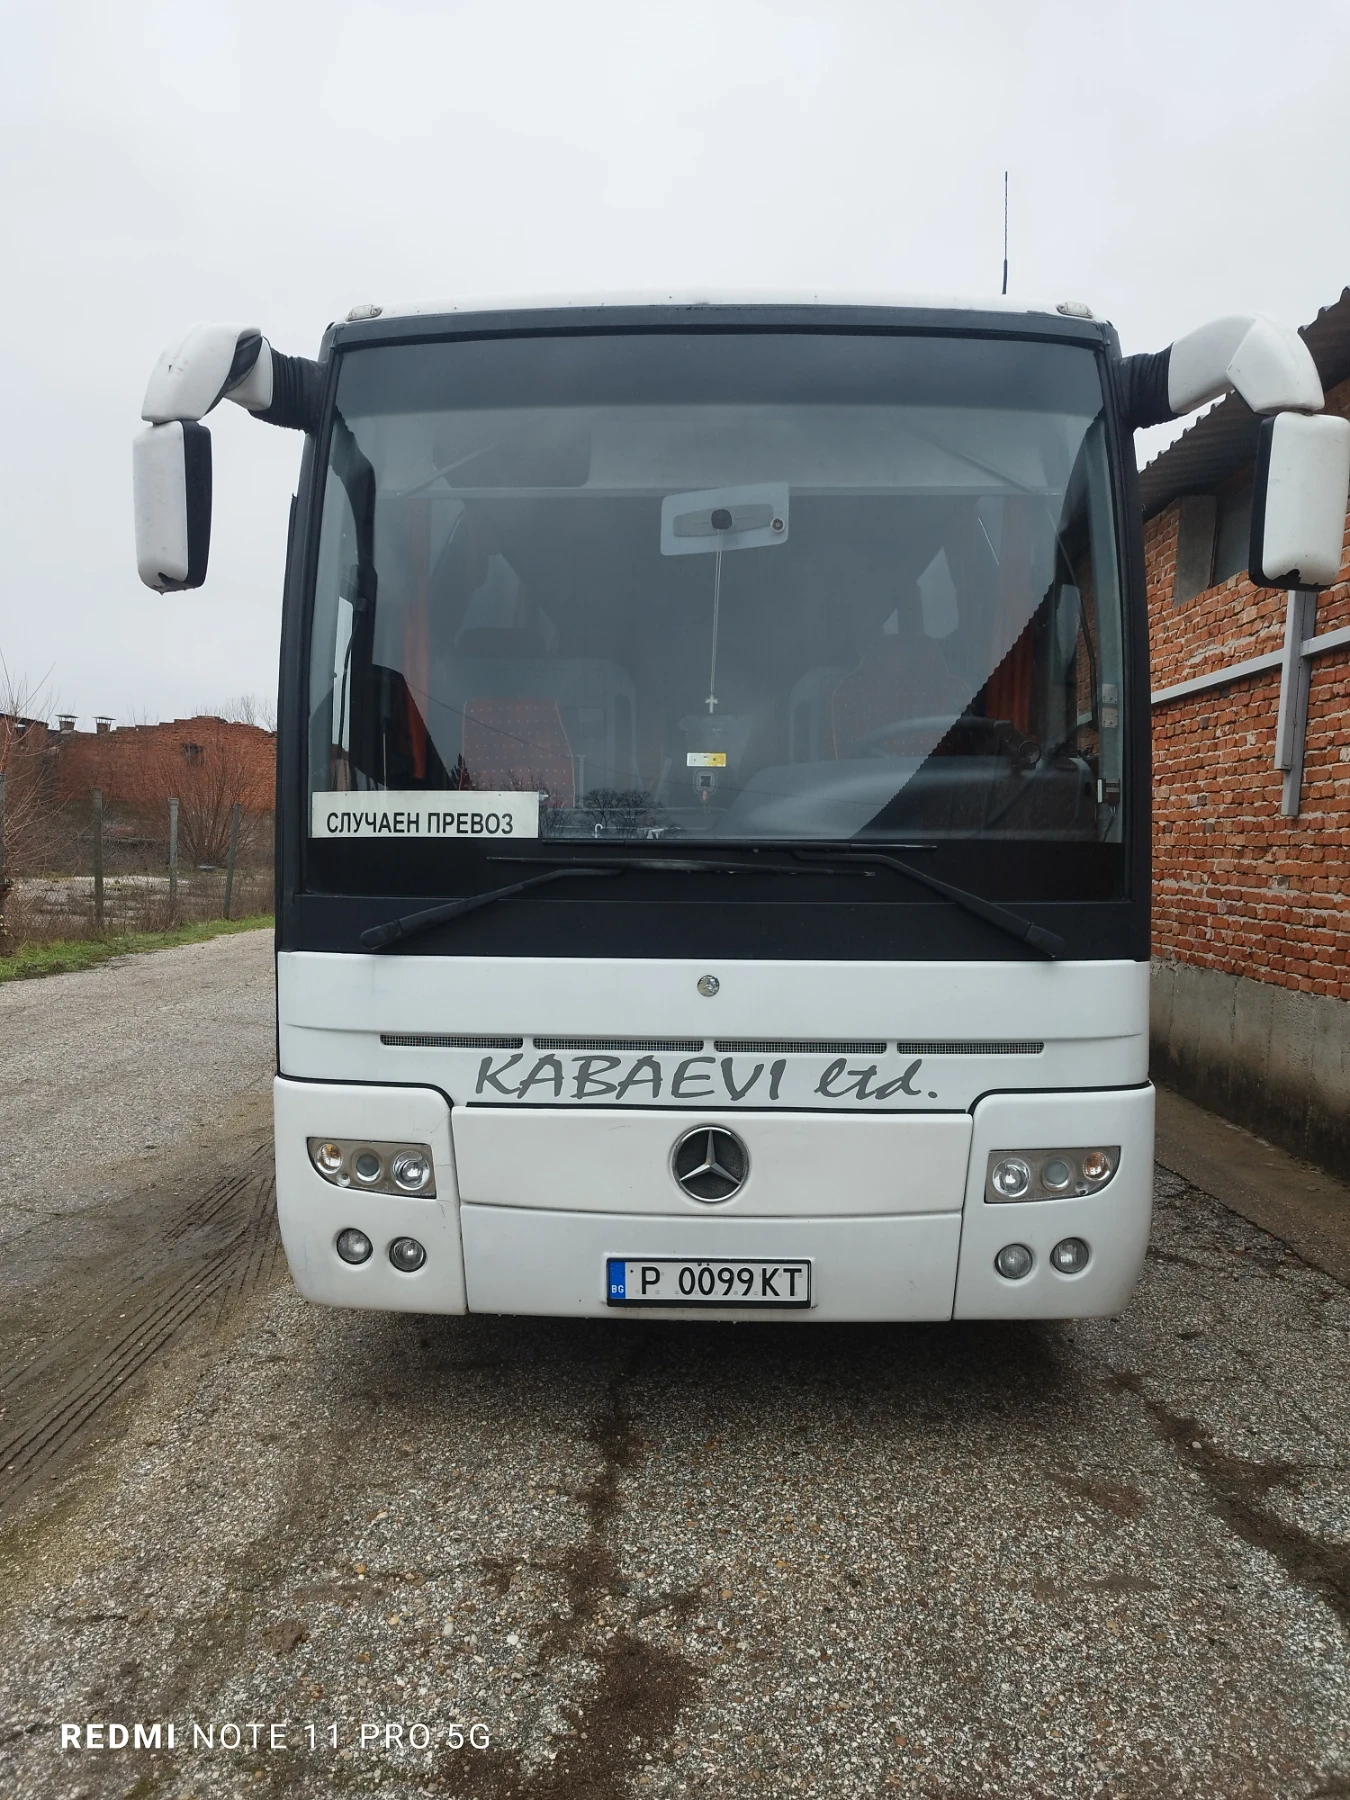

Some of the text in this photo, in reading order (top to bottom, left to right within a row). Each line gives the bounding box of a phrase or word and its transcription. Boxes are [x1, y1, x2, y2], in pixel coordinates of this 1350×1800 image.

[327, 812, 514, 835] СЛУЧАЕН ПРЕВОЗ
[475, 1053, 787, 1101] KABAEVI
[611, 1285, 625, 1293] BG
